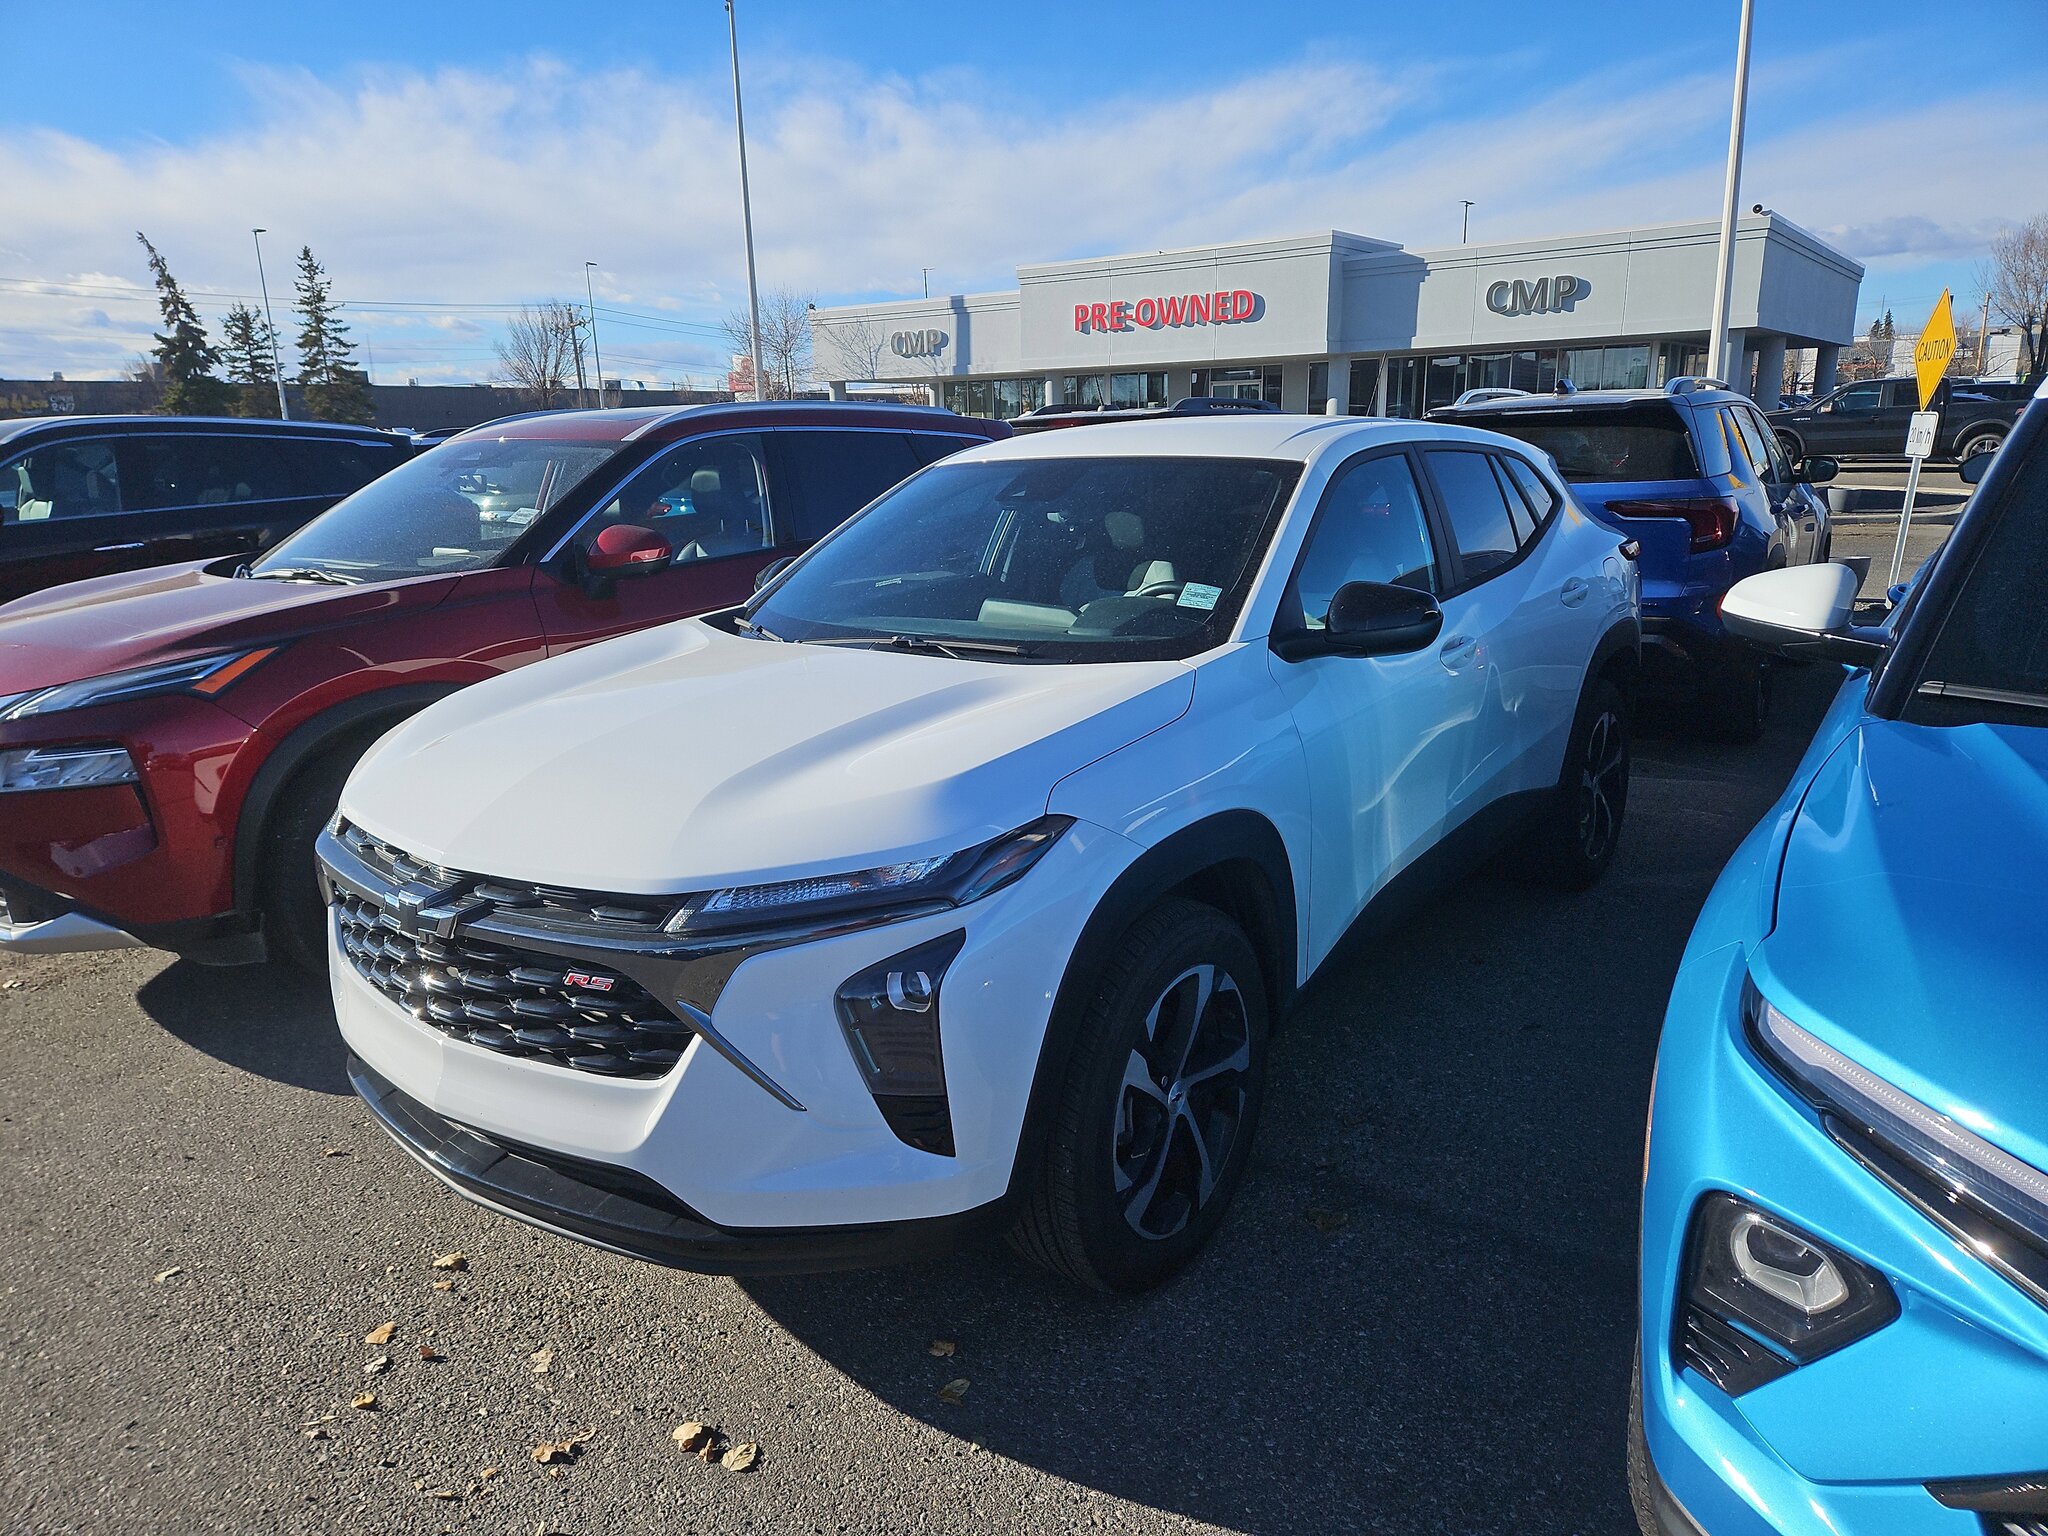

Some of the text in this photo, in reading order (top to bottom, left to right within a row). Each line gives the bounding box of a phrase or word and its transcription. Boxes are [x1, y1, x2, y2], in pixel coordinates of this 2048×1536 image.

[1486, 275, 1578, 313] CMP
[1074, 289, 1255, 333] PRE-OWNED
[891, 329, 942, 356] CMP
[1918, 338, 1951, 362] CAUTION
[564, 971, 615, 991] RS
